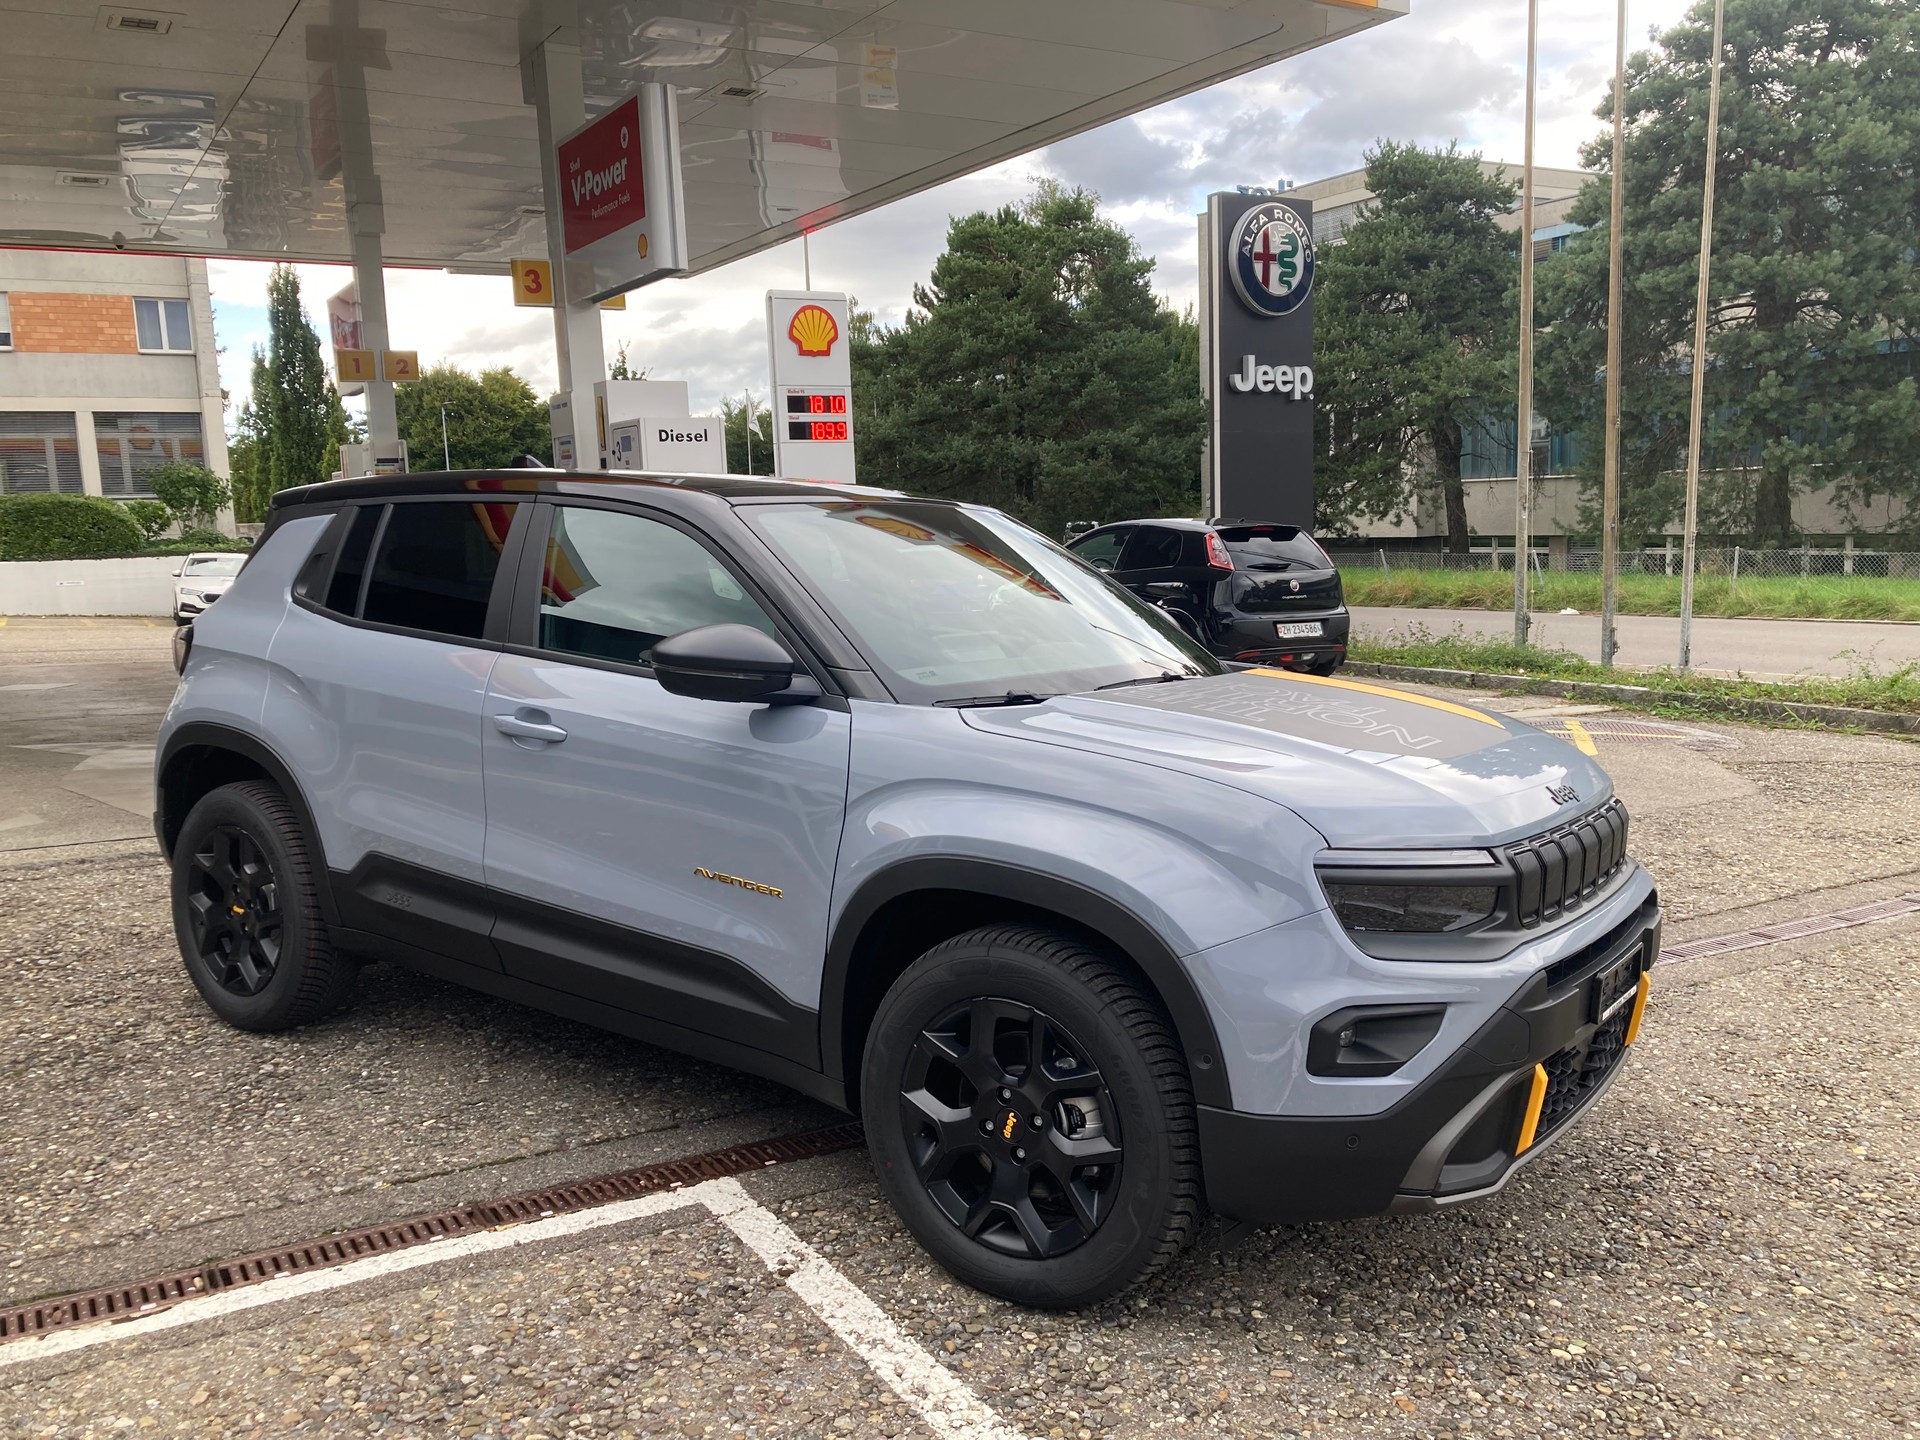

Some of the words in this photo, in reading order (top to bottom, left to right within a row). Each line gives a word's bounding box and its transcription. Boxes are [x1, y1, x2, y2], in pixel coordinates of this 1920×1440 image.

[570, 157, 581, 173] Shell
[571, 157, 627, 206] V-Power
[591, 199, 618, 220] Performance
[618, 189, 631, 206] Fuels
[1242, 213, 1268, 257] ALFA
[1274, 209, 1312, 262] ROMEO
[524, 269, 542, 294] 3
[352, 357, 361, 374] 1
[395, 358, 409, 374] 2
[1229, 354, 1314, 400] Jeep
[809, 395, 846, 414] 181.0
[658, 428, 708, 442] Diesel
[811, 422, 847, 440] 189.9
[615, 440, 622, 462] 3
[1545, 785, 1580, 805] Jeep
[693, 866, 783, 899] AVENGER
[1003, 1112, 1017, 1138] Jeep
